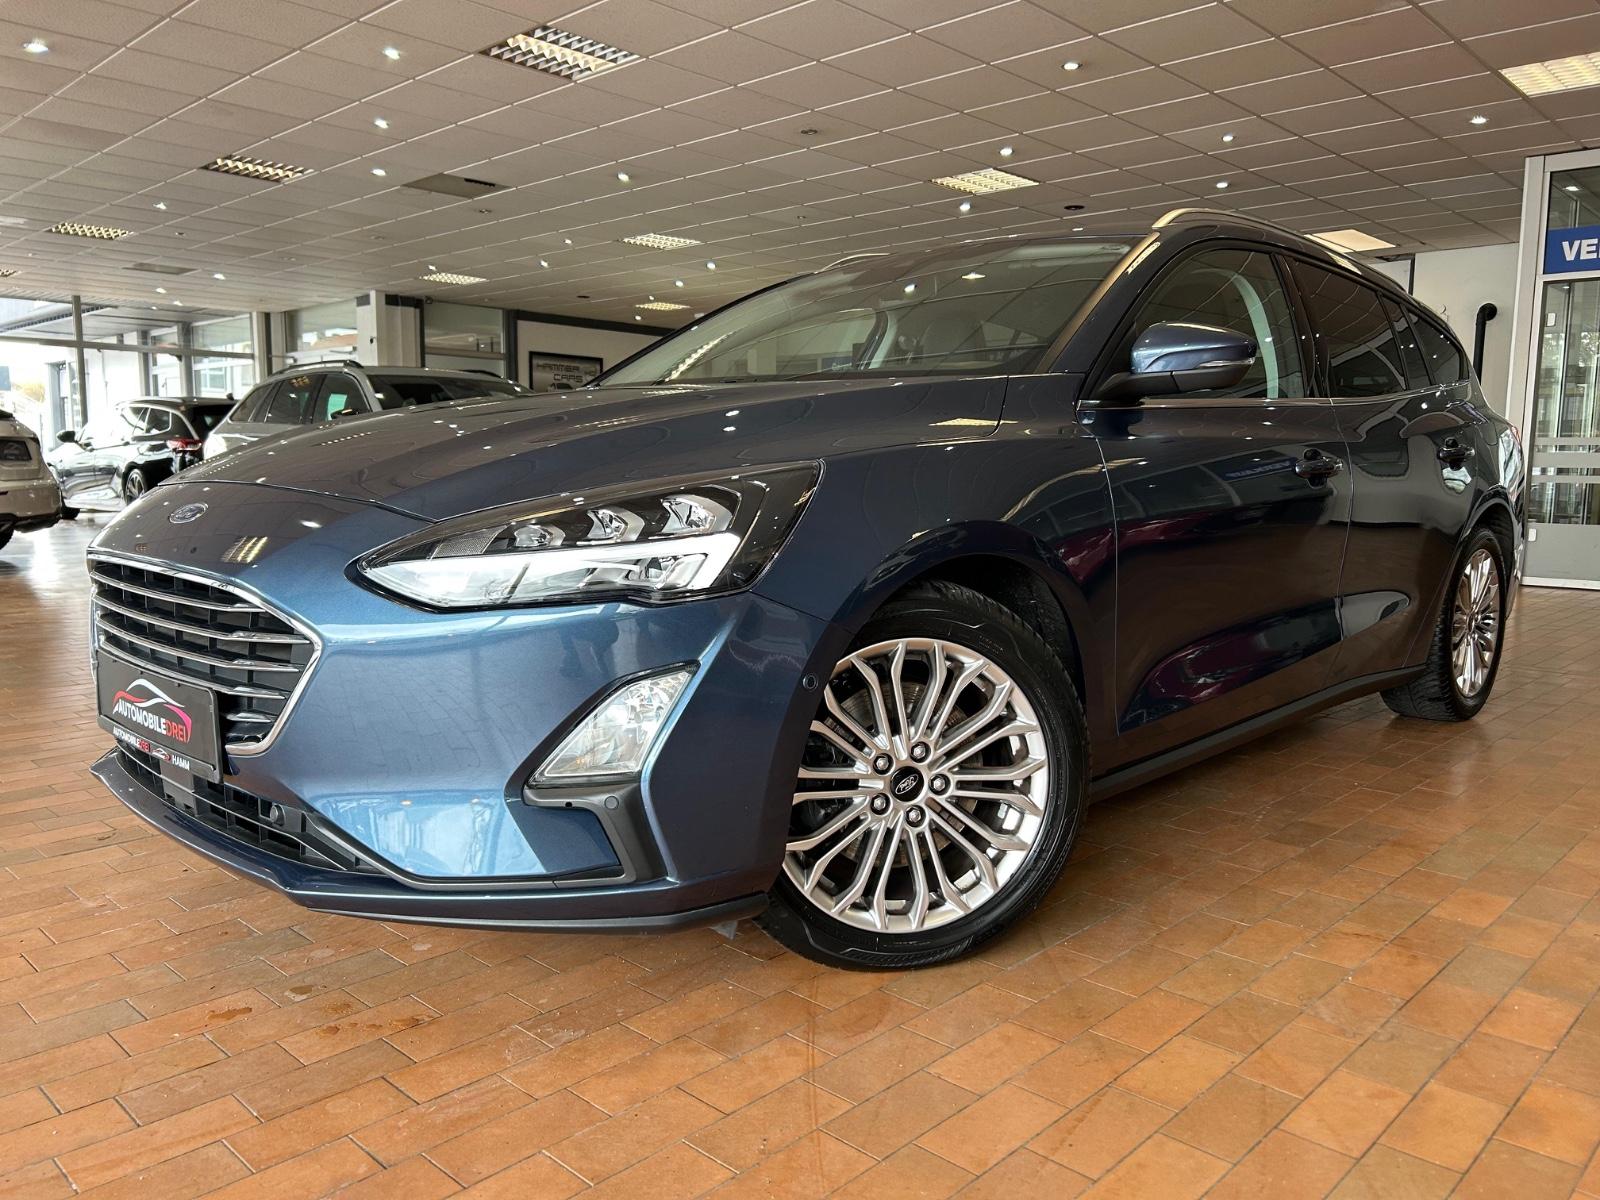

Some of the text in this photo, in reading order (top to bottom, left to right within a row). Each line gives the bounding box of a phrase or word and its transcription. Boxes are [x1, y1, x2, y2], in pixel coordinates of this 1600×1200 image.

[1561, 238, 1600, 261] VE
[171, 754, 190, 771] HAMM
[898, 775, 916, 792] Ford
